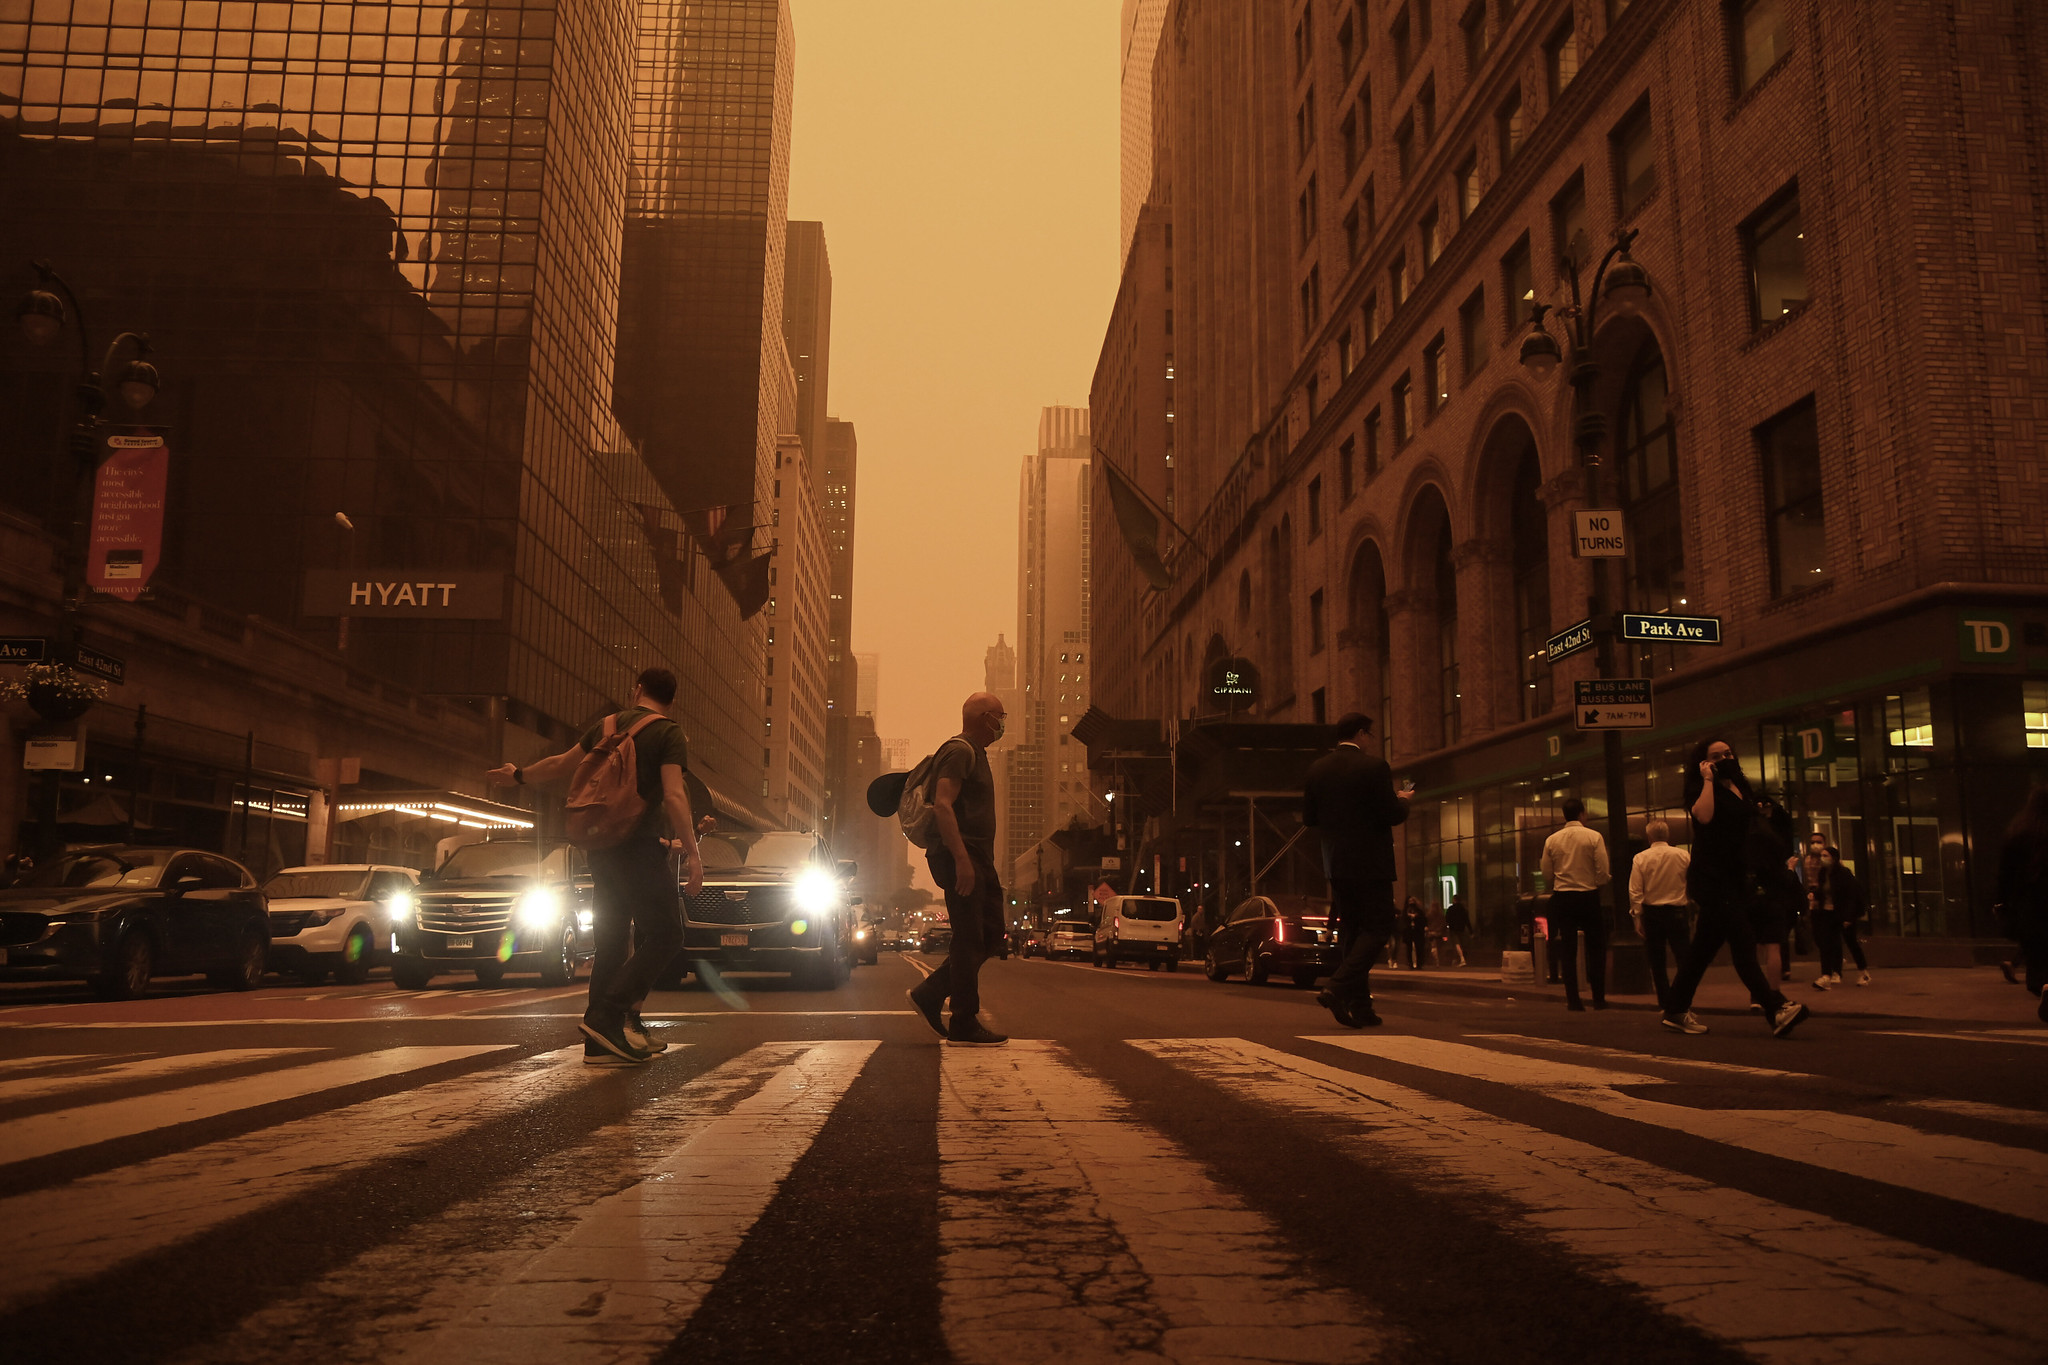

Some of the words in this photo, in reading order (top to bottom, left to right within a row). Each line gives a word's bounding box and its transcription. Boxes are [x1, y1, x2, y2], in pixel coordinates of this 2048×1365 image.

[106, 466, 122, 476] The
[101, 490, 144, 498] accessible
[100, 500, 160, 510] neighborhood
[98, 512, 115, 521] just
[116, 513, 130, 521] got
[1589, 518, 1609, 531] NO
[1580, 537, 1623, 550] TURNS
[92, 586, 129, 594] MIDTOWN
[131, 586, 151, 594] EAST
[350, 582, 456, 607] HYATT
[1640, 621, 1673, 637] Park
[1676, 623, 1703, 638] Ave
[1548, 638, 1564, 657] East
[1564, 630, 1581, 650] 42nd
[1581, 628, 1590, 641] St
[1963, 620, 2010, 653] TD
[0, 644, 28, 656] Ave
[79, 650, 94, 667] East
[95, 658, 113, 673] 42nd
[113, 665, 121, 677] St
[1213, 686, 1252, 694] CIPRIANI
[1594, 683, 1616, 692] BUS
[1618, 682, 1645, 691] LANE
[1581, 695, 1615, 704] BUSES
[1617, 694, 1645, 703] ONLY
[1605, 712, 1646, 720] 7AM-7PM
[1547, 735, 1560, 757] TD
[1797, 728, 1823, 759] TD
[1438, 875, 1457, 909] TD
